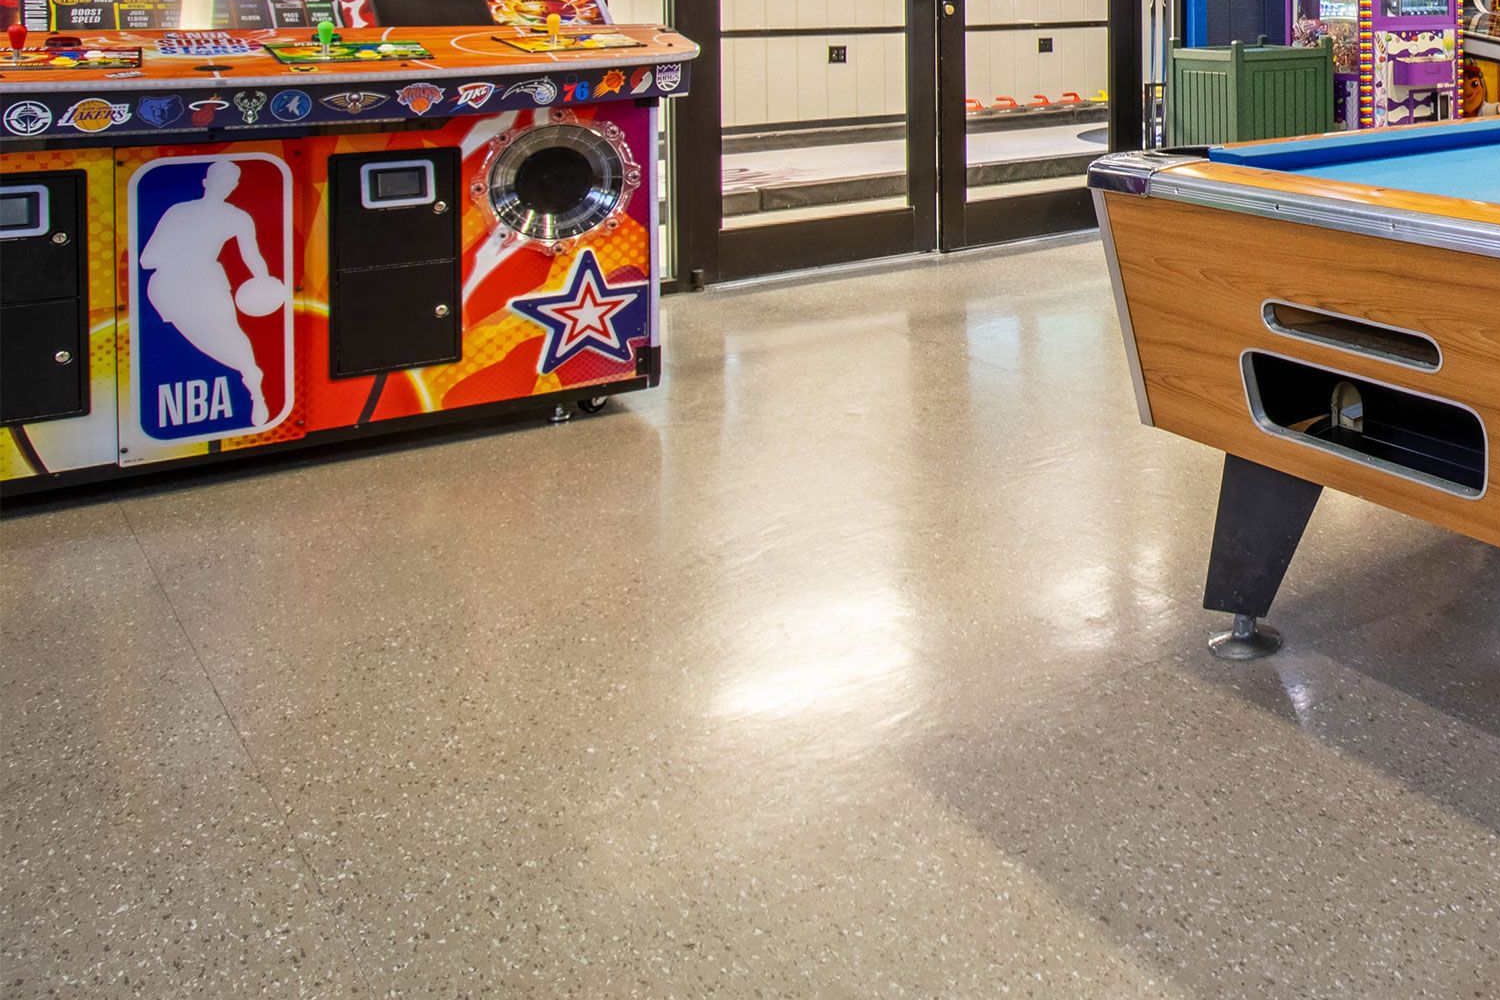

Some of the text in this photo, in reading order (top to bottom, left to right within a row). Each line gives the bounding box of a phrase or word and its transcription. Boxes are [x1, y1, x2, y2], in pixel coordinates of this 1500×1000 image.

[71, 8, 102, 16] BOOST
[158, 39, 244, 47] SUPER
[184, 32, 232, 40] NBA
[160, 46, 249, 56] STARS
[458, 85, 489, 105] OKC
[563, 81, 589, 101] 76
[64, 105, 124, 124] LAKERS
[158, 376, 234, 428] NBA
